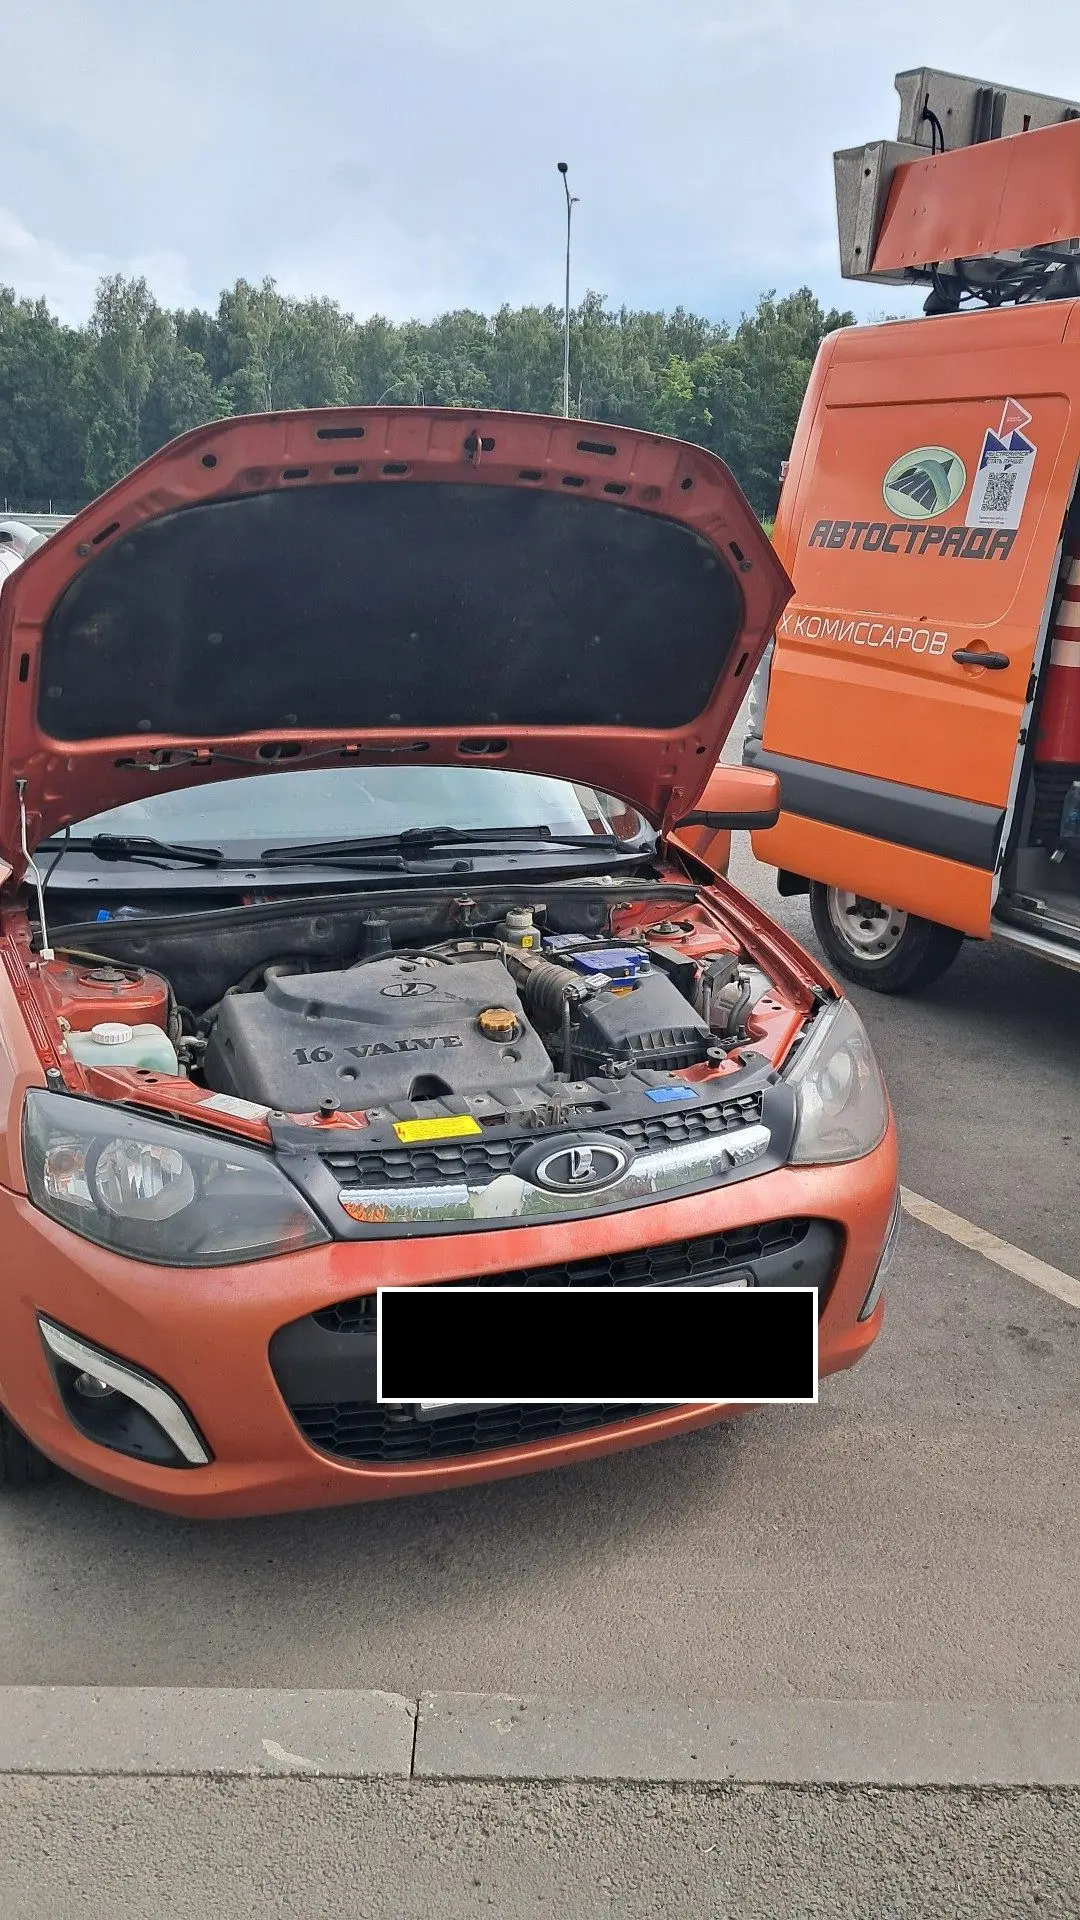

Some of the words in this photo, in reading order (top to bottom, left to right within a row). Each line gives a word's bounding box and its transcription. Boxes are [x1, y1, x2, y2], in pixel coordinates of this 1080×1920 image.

[808, 520, 1019, 561] АВТОСТРАДА
[793, 615, 948, 656] КОМИССАРОВ
[293, 1046, 334, 1066] 16
[344, 1035, 464, 1059] VALVE
